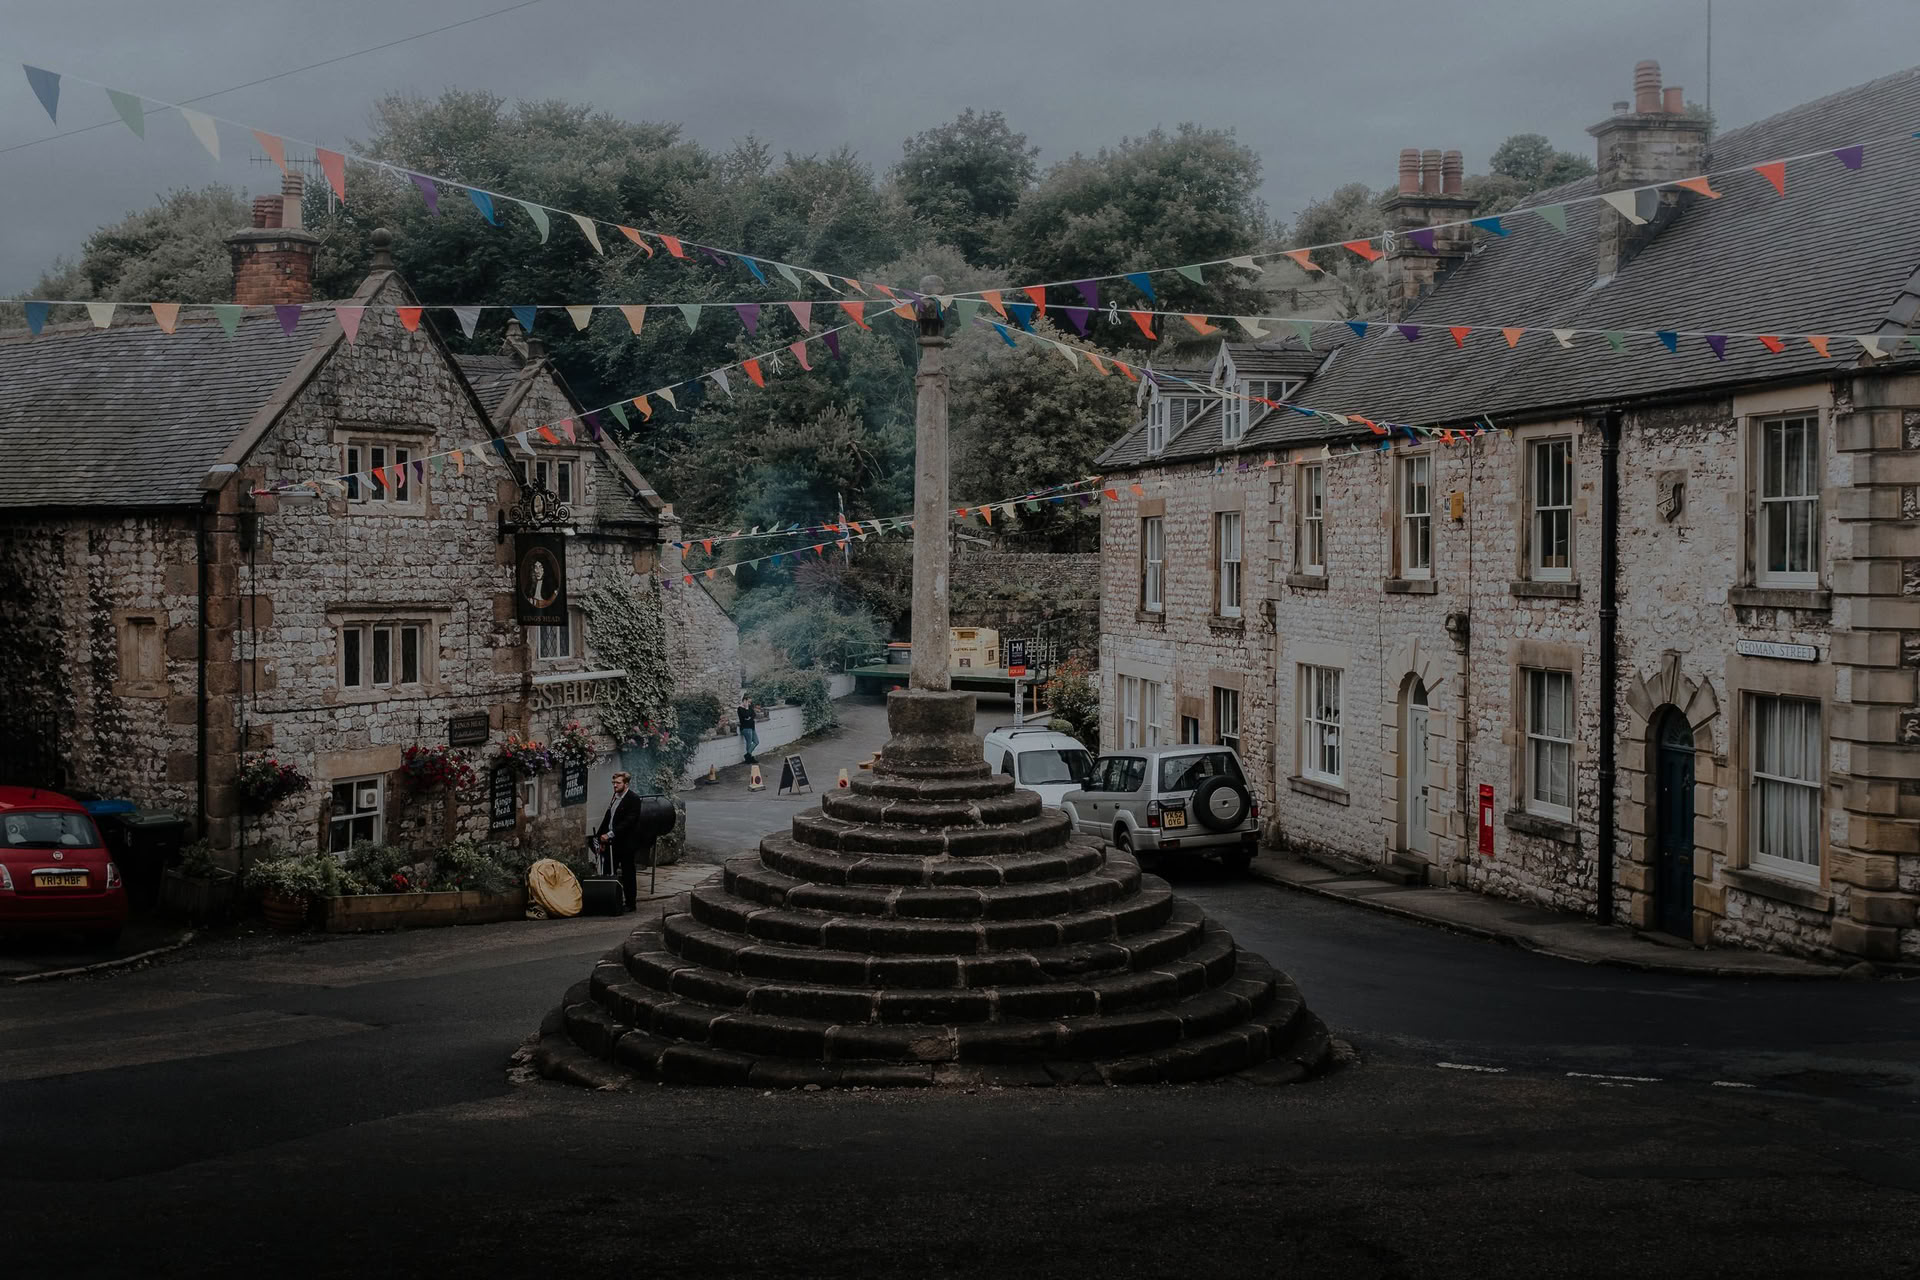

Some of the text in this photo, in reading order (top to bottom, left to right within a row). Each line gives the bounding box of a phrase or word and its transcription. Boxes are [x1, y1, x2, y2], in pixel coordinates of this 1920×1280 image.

[1739, 641, 1814, 658] YEOMAN STREET
[562, 678, 620, 706] HEAD
[453, 719, 485, 729] KINGS HEAD
[1166, 811, 1183, 819] YK52
[40, 876, 81, 886] YR13 HBF
